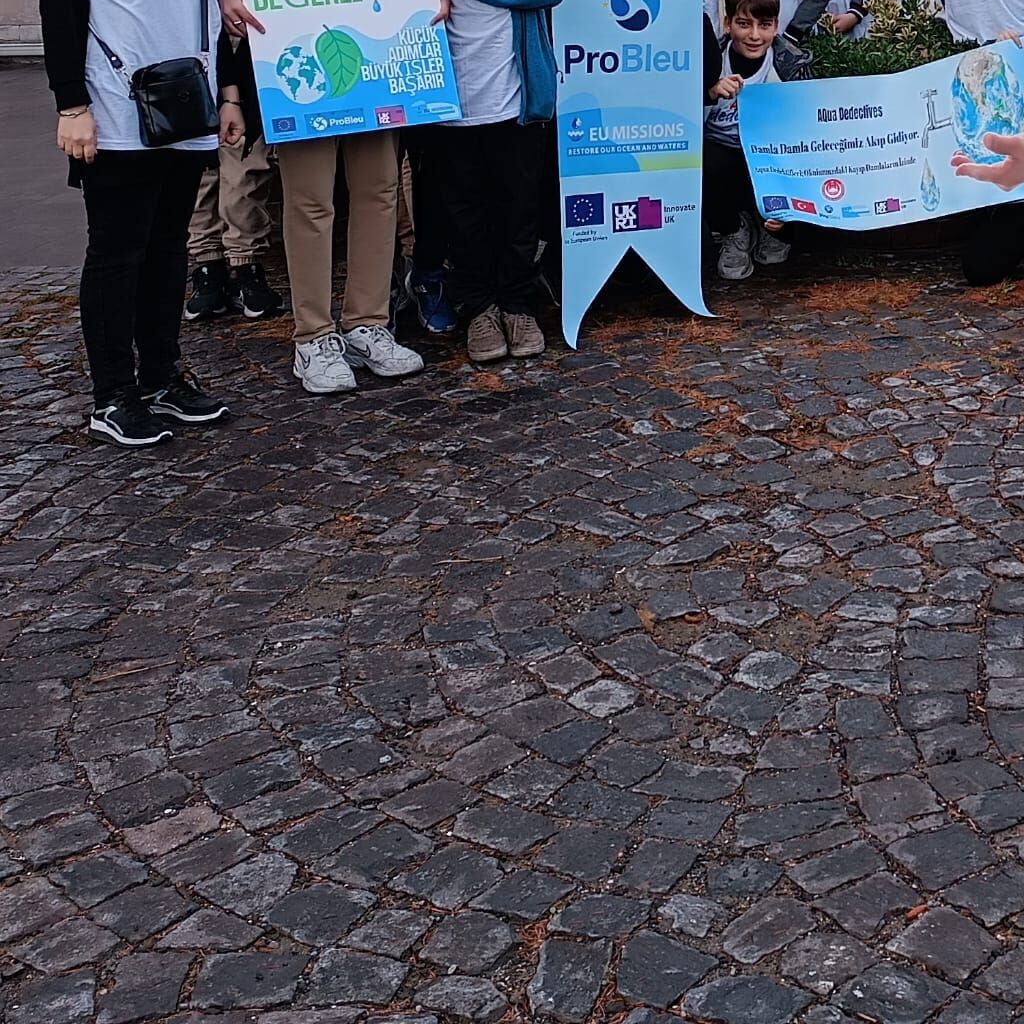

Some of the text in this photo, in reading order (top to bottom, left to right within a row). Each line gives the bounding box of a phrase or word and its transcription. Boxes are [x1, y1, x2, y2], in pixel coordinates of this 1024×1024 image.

[563, 43, 691, 74] ProBleu
[361, 60, 403, 82] BÜYÜK
[389, 72, 445, 97] BAŞARIR
[838, 104, 884, 121] Dedectives
[329, 115, 364, 128] ProBleu
[589, 123, 686, 142] EU MISSIONS
[568, 142, 687, 156] RESTORE OUR OCEAN AND WATERS
[750, 144, 778, 154] Damla
[779, 141, 809, 155] Damla
[810, 138, 863, 153] Geleceğimiz
[664, 215, 675, 224] UK
